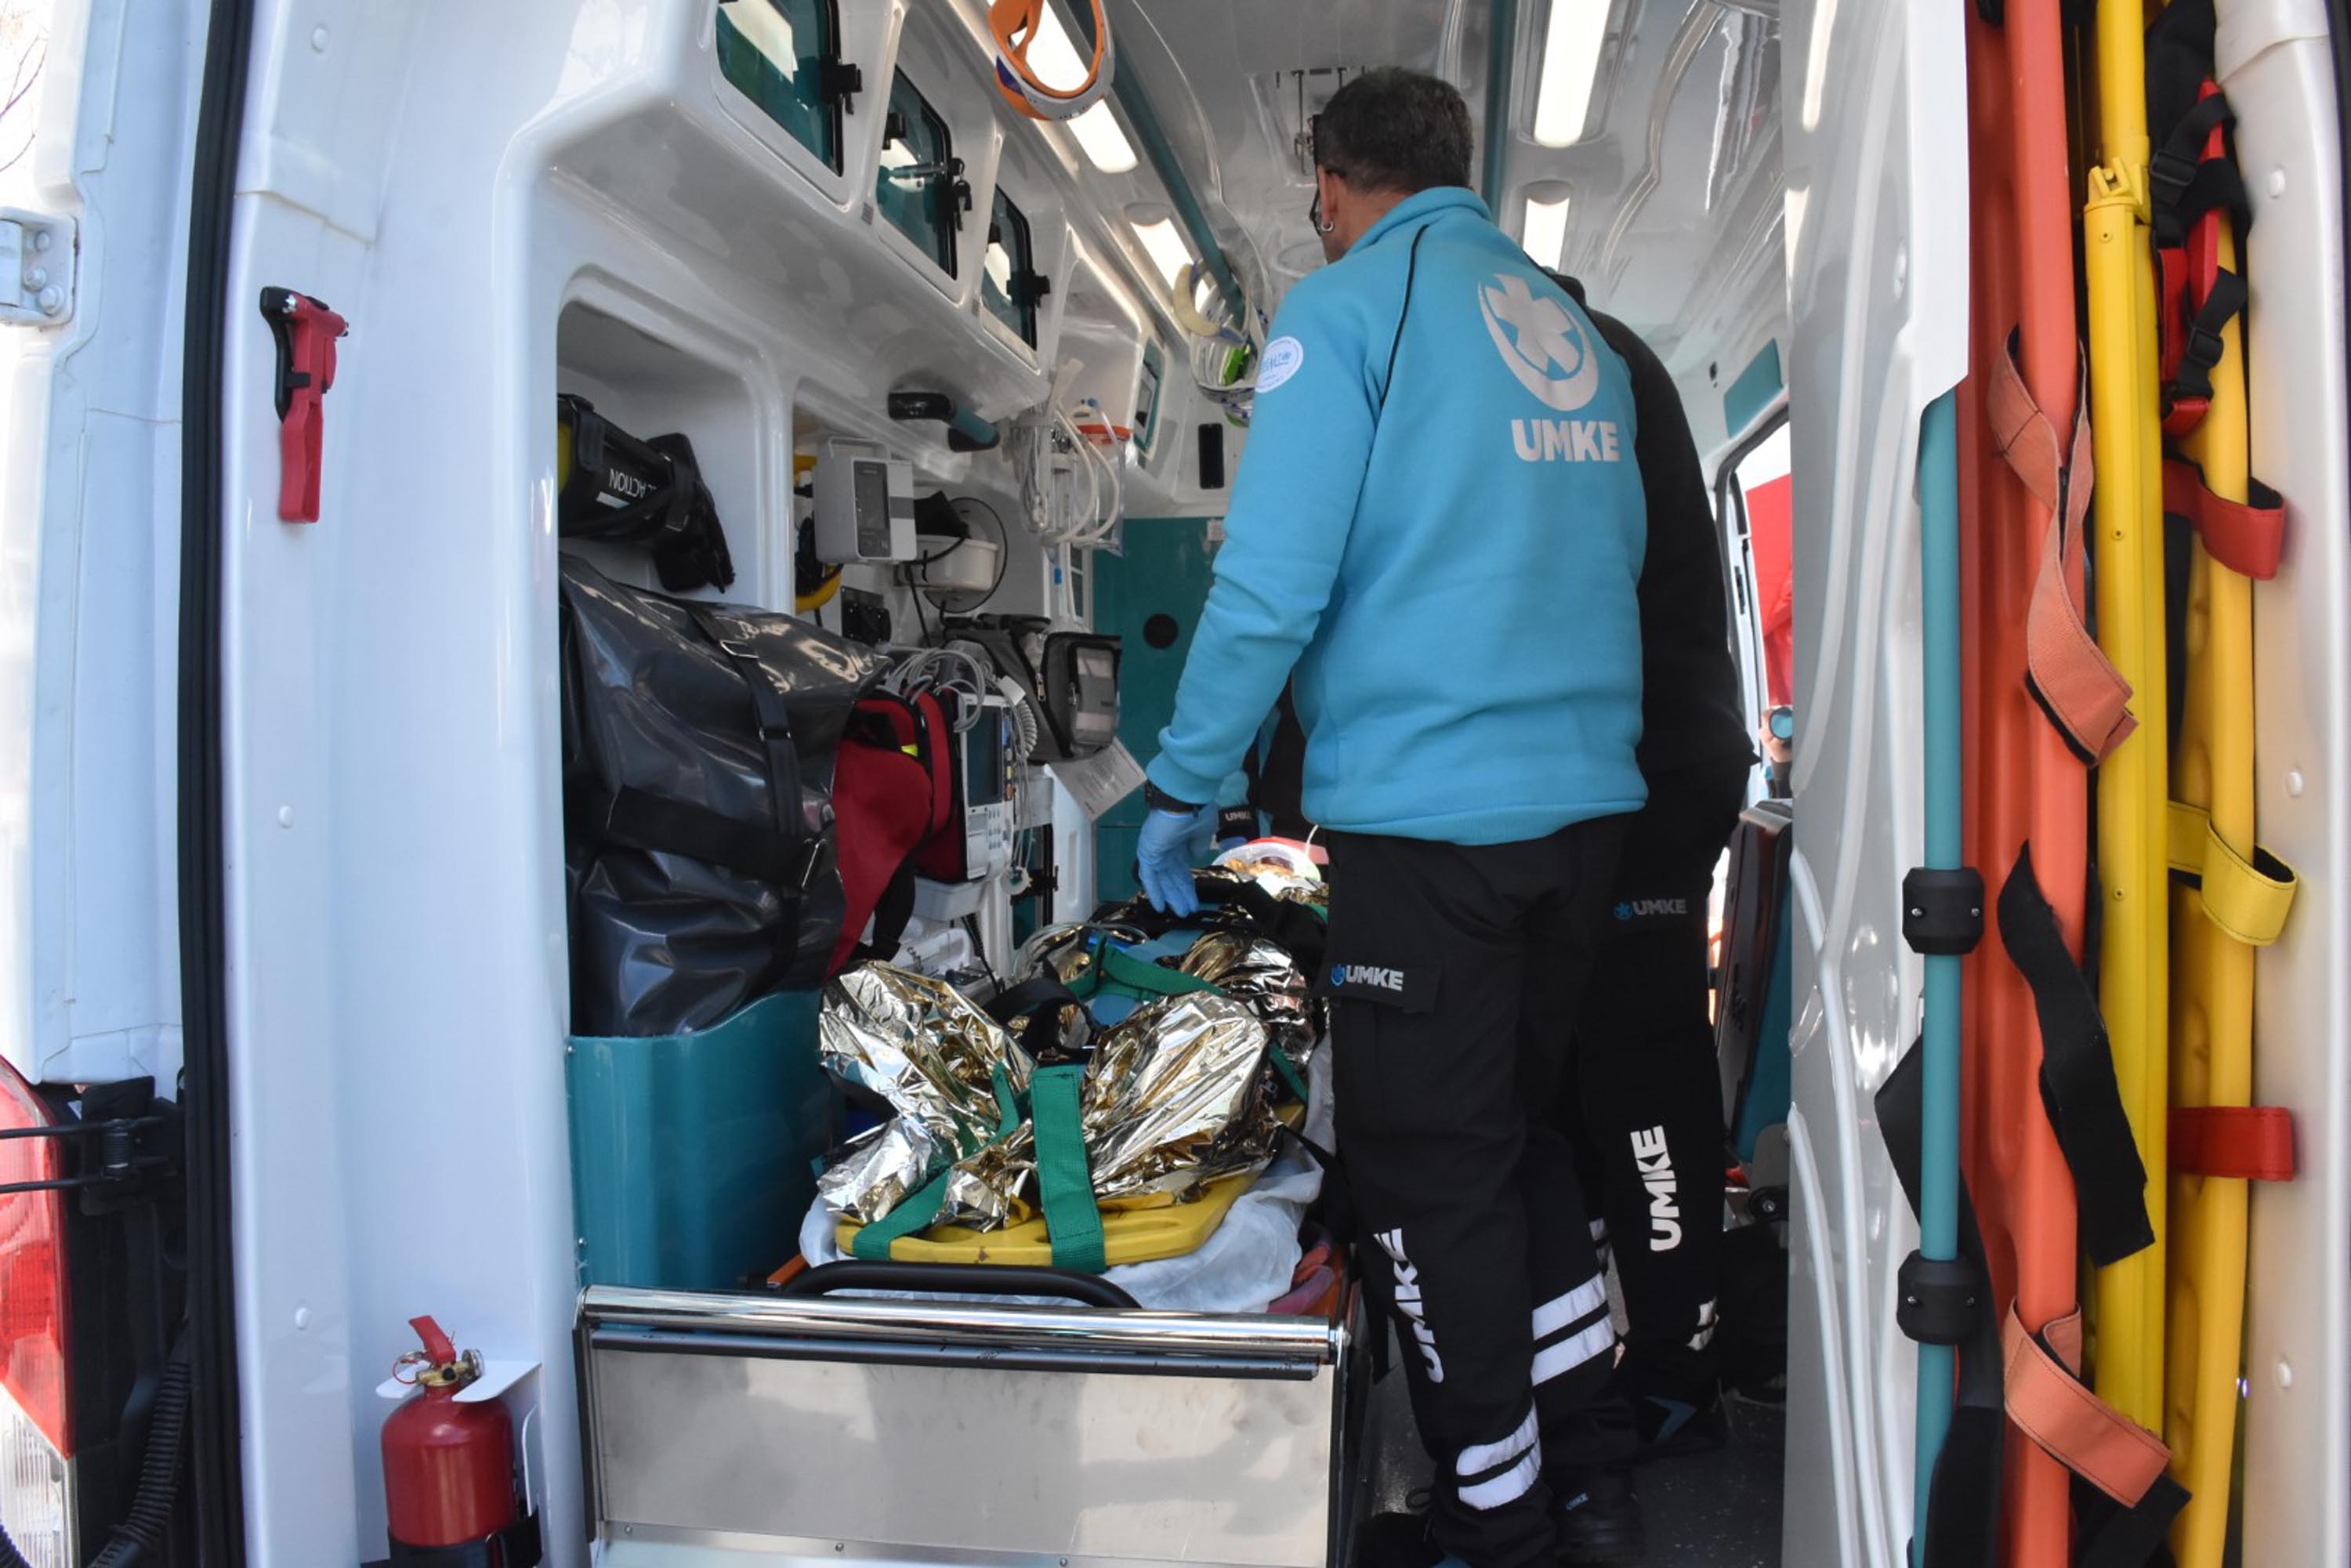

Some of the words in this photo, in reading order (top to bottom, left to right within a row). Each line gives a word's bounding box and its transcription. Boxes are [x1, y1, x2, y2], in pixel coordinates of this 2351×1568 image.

[1511, 418, 1620, 462] UMKE
[1632, 899, 1687, 916] UMKE
[1346, 965, 1404, 992] UMKE
[1630, 1124, 1683, 1251] UMKE
[1373, 1227, 1444, 1384] UMKE
